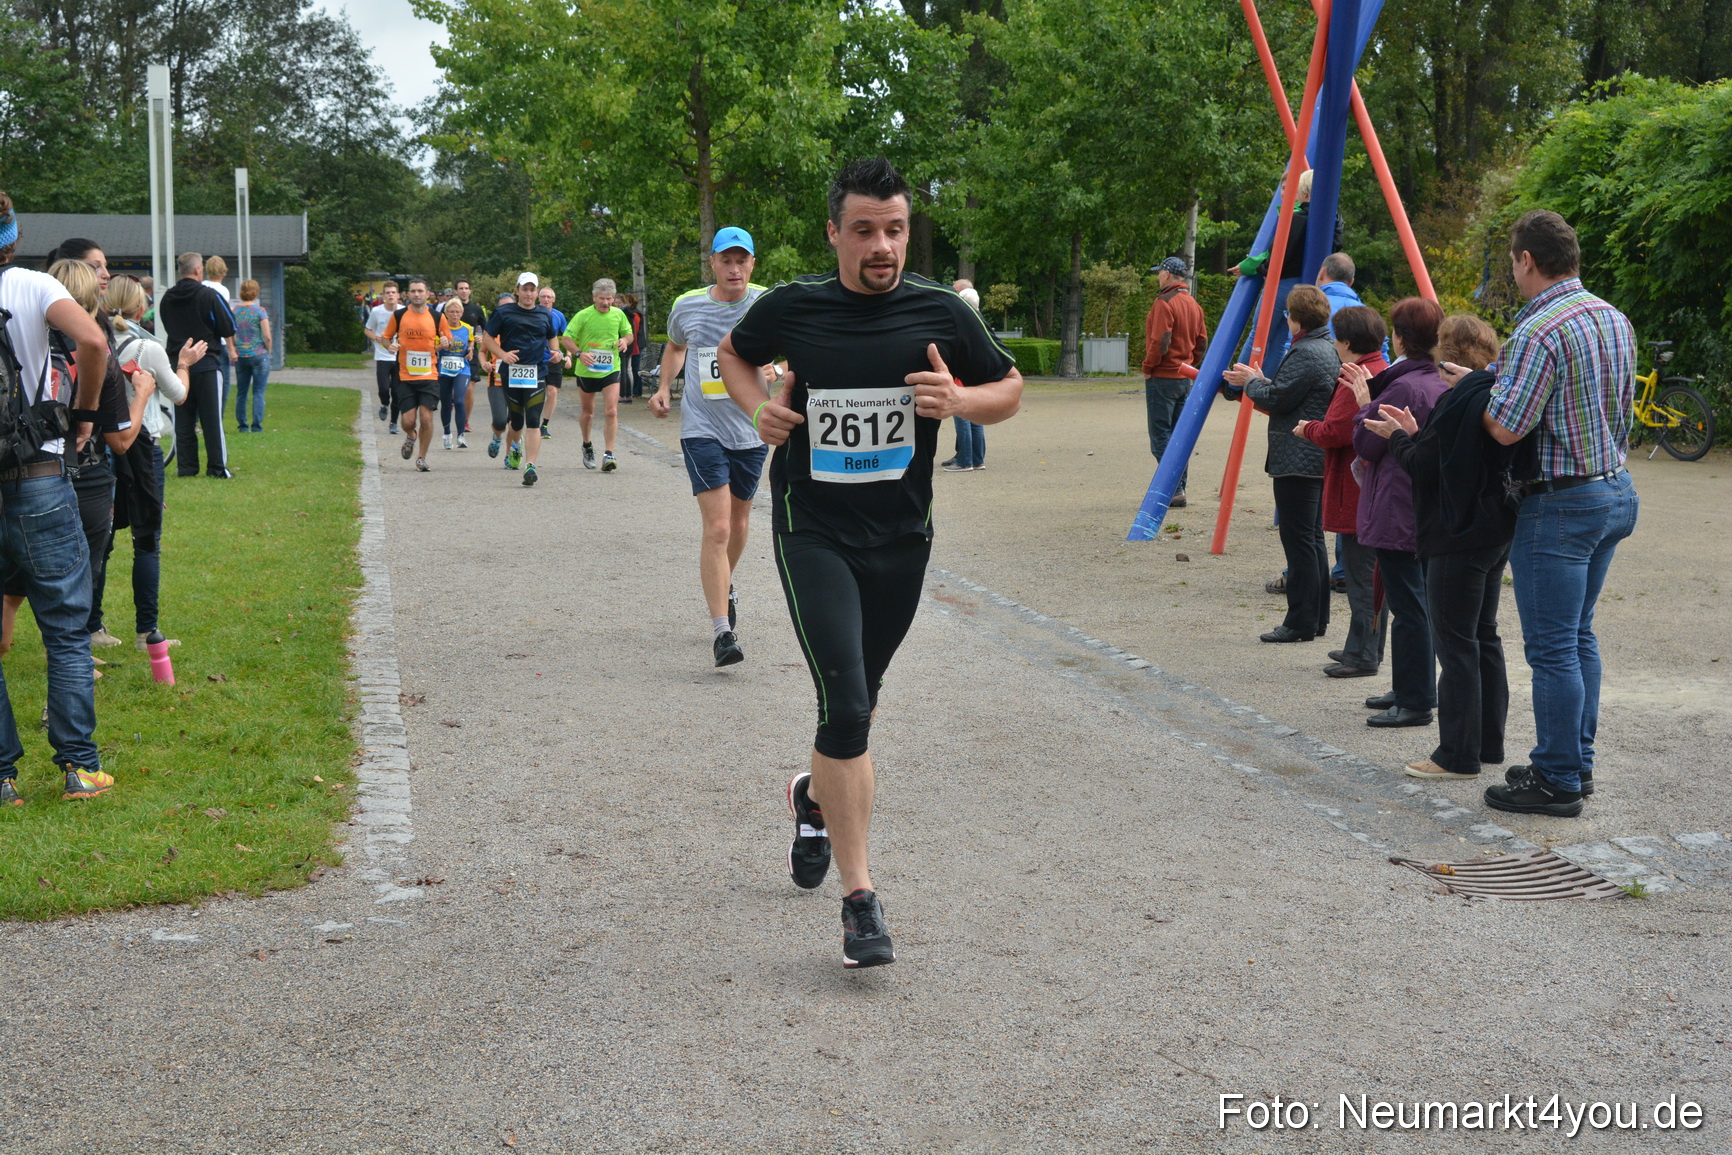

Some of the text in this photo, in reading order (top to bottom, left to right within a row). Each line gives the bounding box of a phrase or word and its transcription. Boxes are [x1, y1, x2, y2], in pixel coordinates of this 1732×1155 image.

[411, 357, 427, 366] 611
[443, 361, 463, 369] 2014
[512, 368, 535, 378] 2328
[809, 398, 897, 408] PARTL Neumarkt
[819, 411, 905, 448] 2612
[844, 455, 879, 470] René
